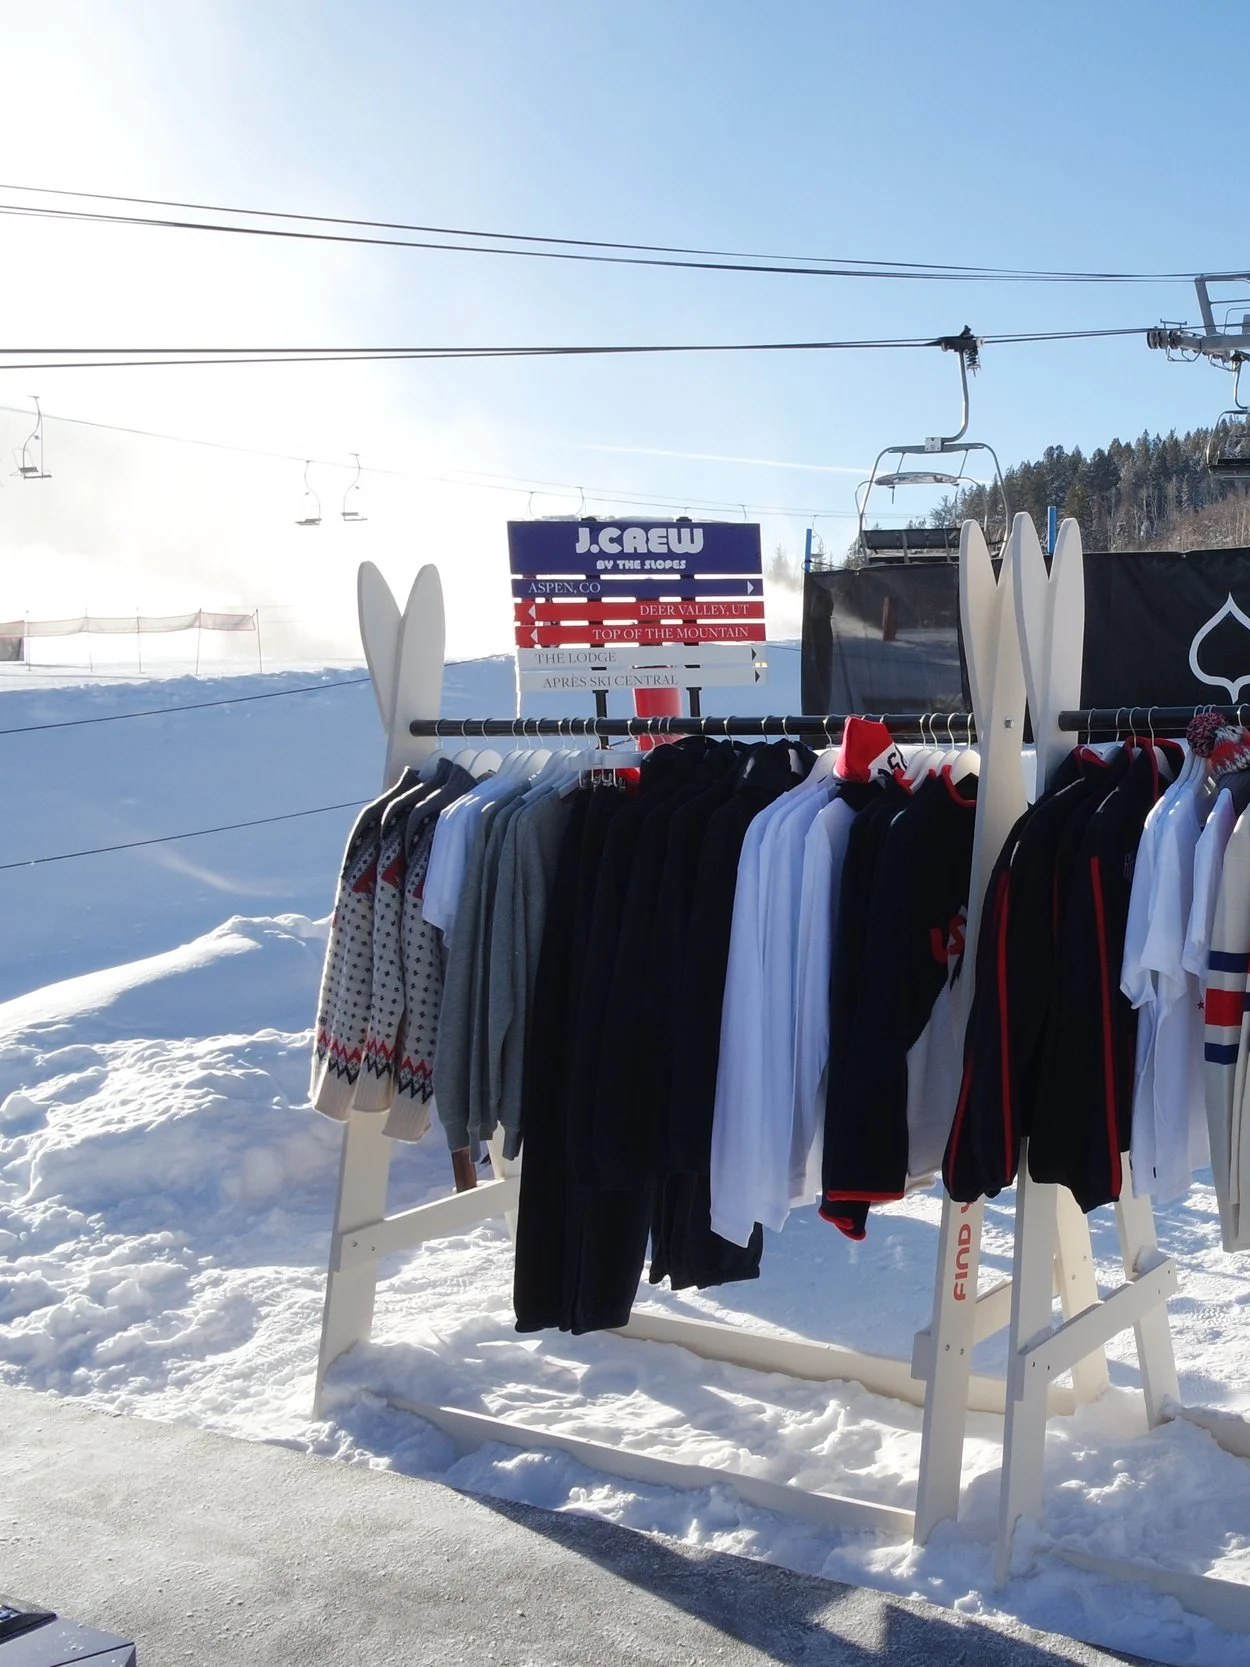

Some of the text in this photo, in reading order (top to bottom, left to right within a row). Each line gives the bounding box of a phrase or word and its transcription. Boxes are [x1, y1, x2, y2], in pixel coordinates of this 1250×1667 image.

[575, 527, 704, 554] J.CREW
[596, 560, 687, 570] BY THE SLOPES
[528, 582, 601, 595] ASPEN, CO
[640, 604, 749, 616] DEER VALLEY, UT
[592, 626, 749, 640] TOP OF THE MOUNTAIN
[535, 652, 617, 664] THE LODGE
[543, 674, 679, 688] APRÈS SKI CENTRAL
[953, 1223, 972, 1302] FIND
